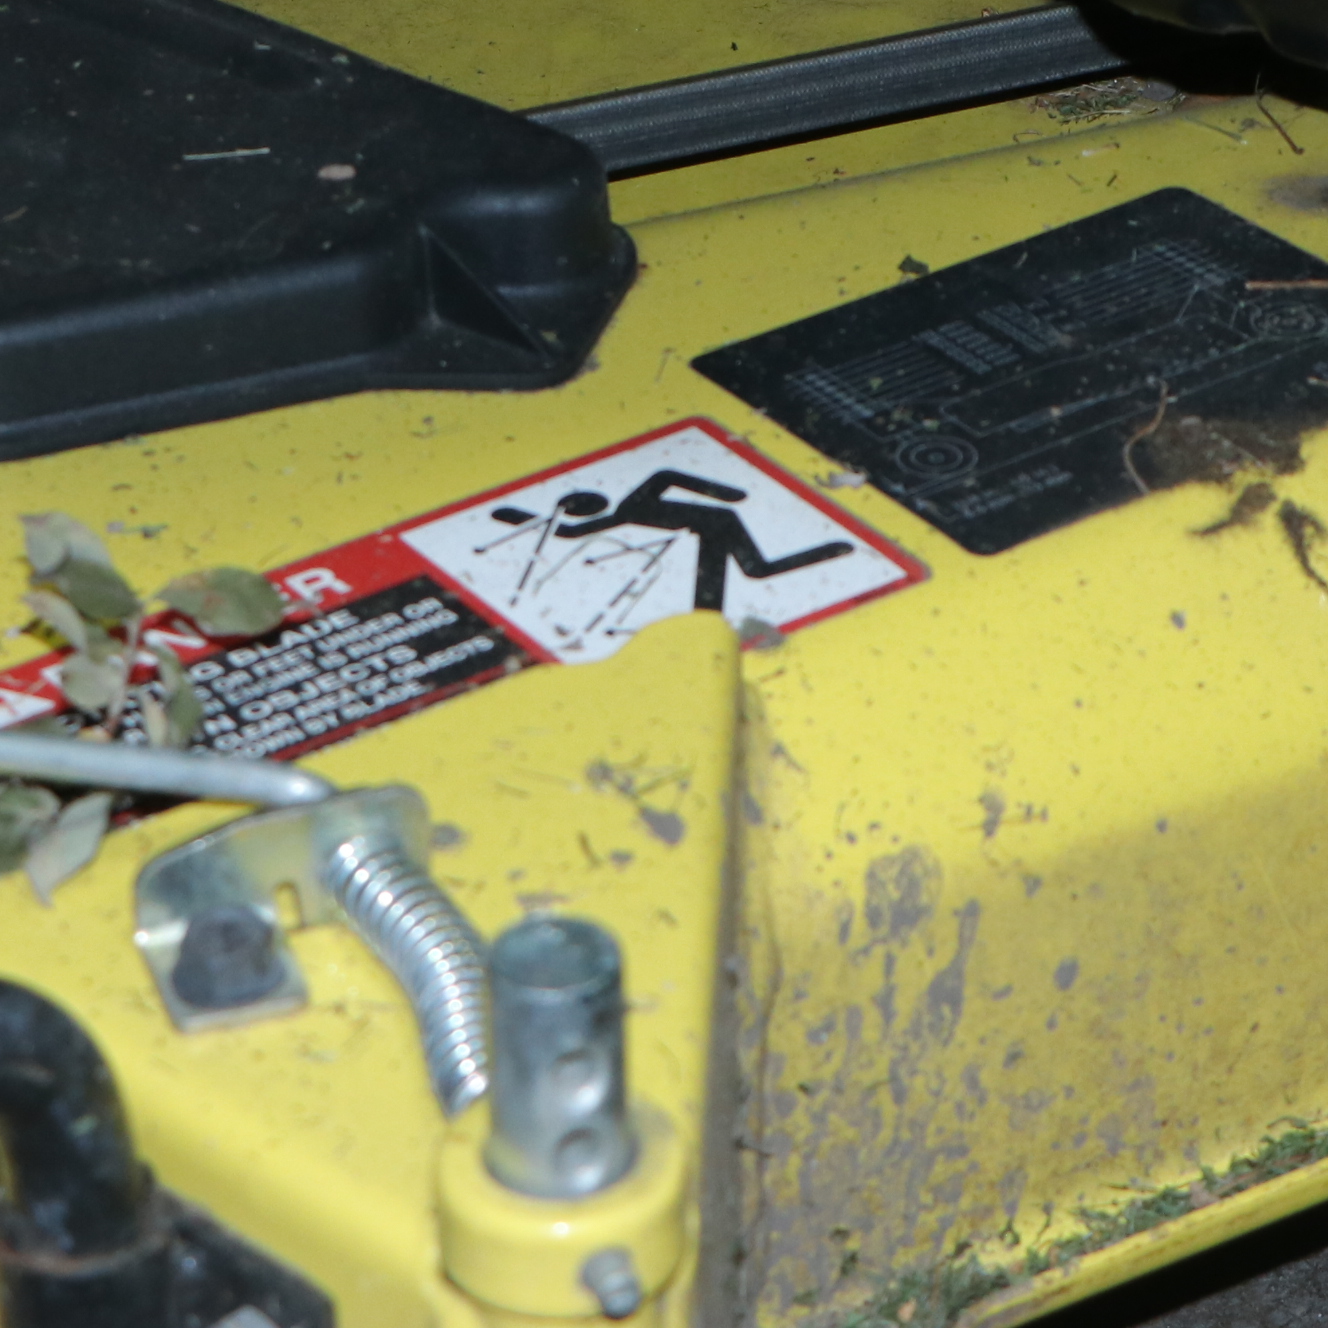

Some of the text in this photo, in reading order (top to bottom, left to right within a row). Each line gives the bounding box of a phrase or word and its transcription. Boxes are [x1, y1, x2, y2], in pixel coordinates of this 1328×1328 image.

[211, 597, 443, 693] OR FEET UNDER OR
[224, 661, 320, 706] ENGINE
[317, 651, 348, 671] IS
[345, 608, 459, 660] RUNNING
[227, 609, 359, 667] BLADE
[214, 712, 296, 751] CLEAR
[294, 688, 361, 722] AREA
[355, 673, 389, 696] OF
[388, 635, 494, 684] OBJECTS
[239, 644, 418, 721] OBJECTS
[302, 711, 339, 735] BY
